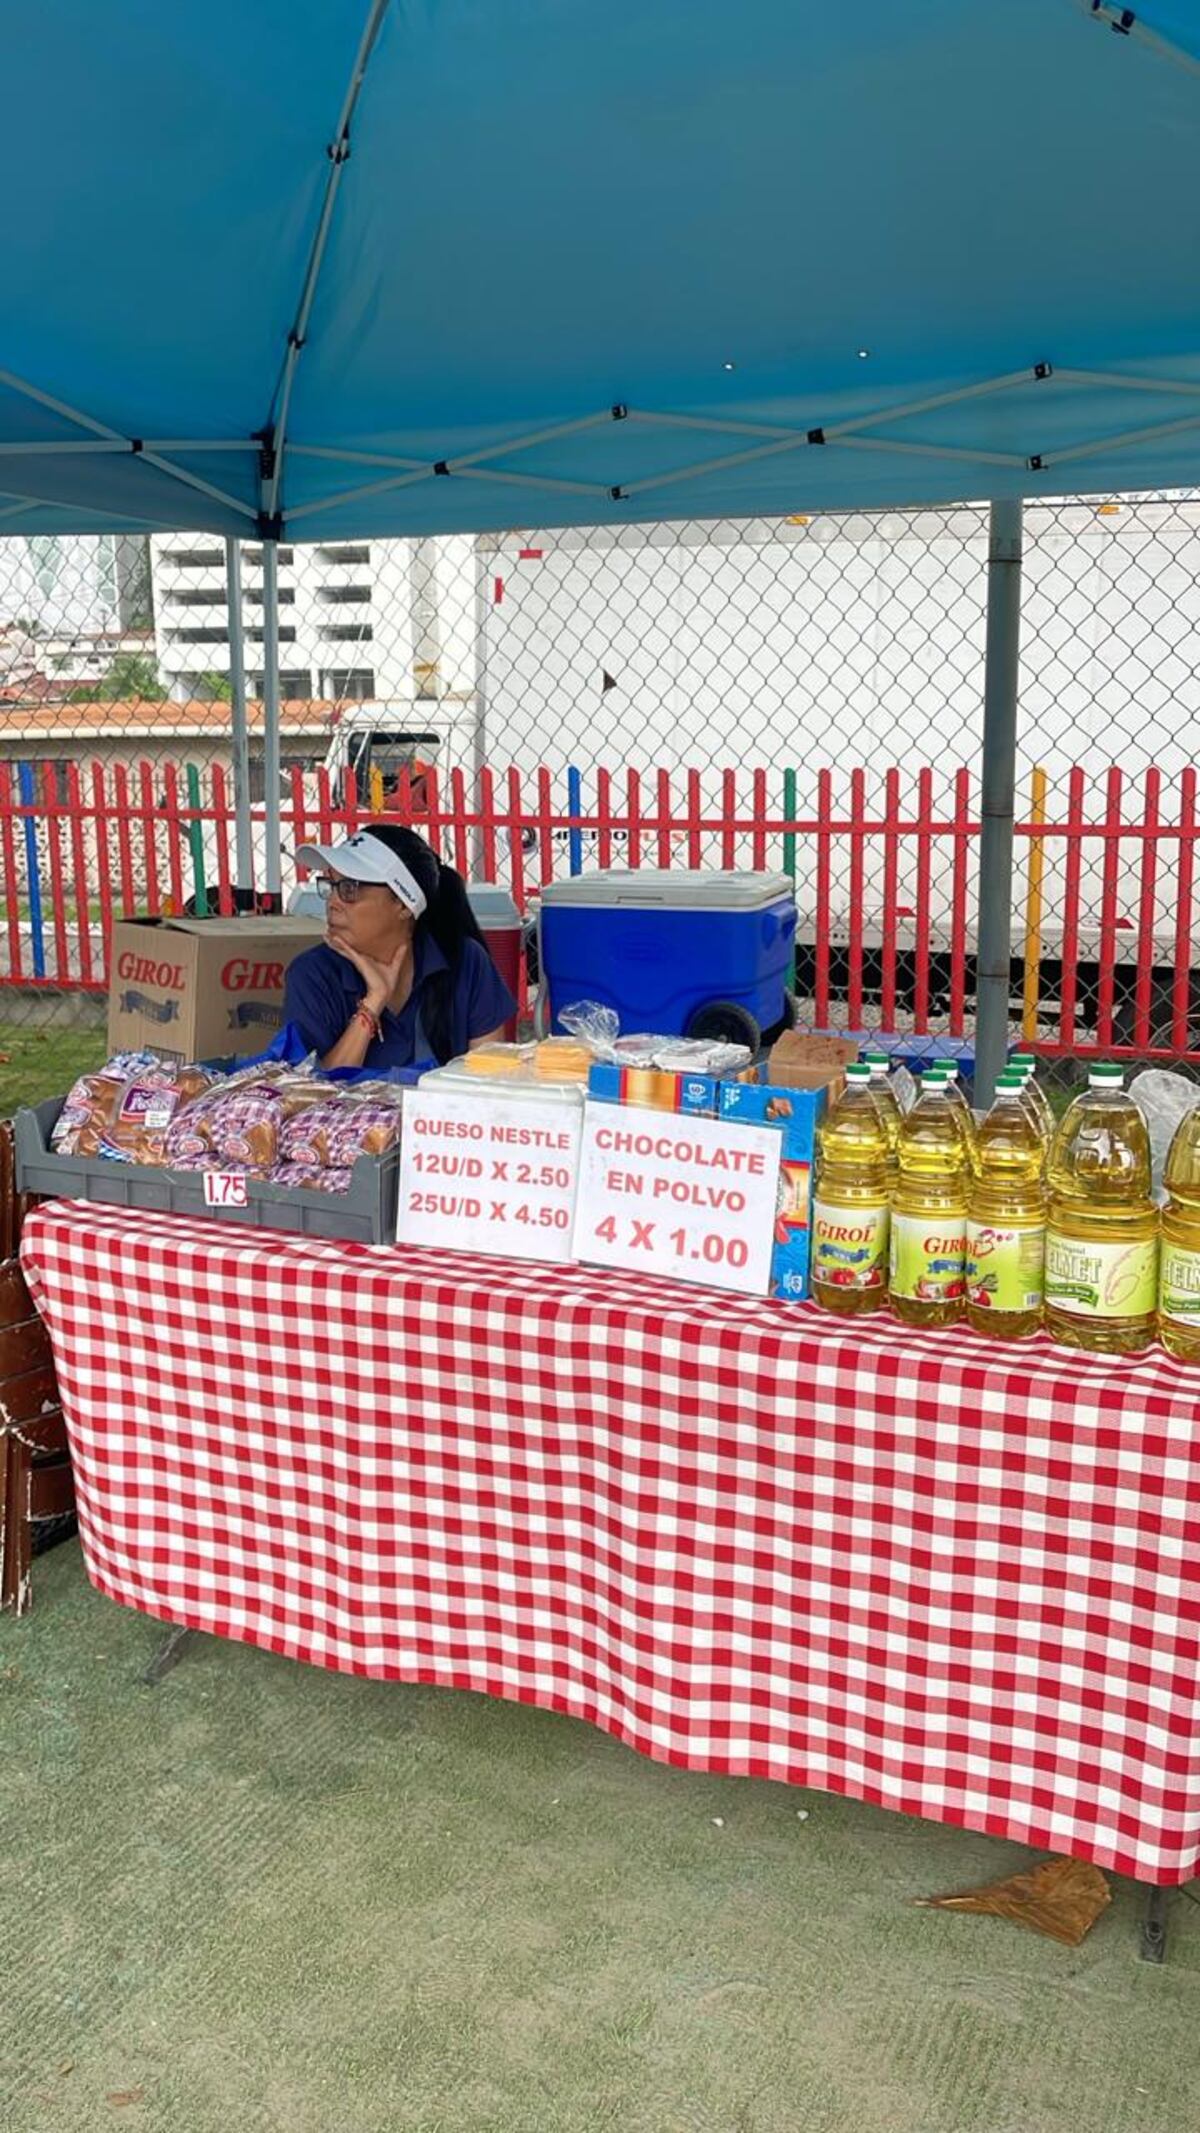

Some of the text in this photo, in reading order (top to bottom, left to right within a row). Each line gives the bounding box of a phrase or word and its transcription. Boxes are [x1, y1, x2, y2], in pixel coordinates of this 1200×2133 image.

[118, 952, 185, 990] GIROL
[220, 958, 284, 991] GIR
[414, 1119, 568, 1149] QUESO NESTLE
[414, 1153, 570, 1187] 12U/D X 2.50
[595, 1128, 765, 1177] CHOCOLATE
[208, 1174, 247, 1204] 1.75
[607, 1171, 746, 1213] EN POLVO
[409, 1192, 569, 1229] 25U/D X 4.50
[595, 1215, 749, 1269] 4 X 1.00
[816, 1220, 873, 1243] GIROL
